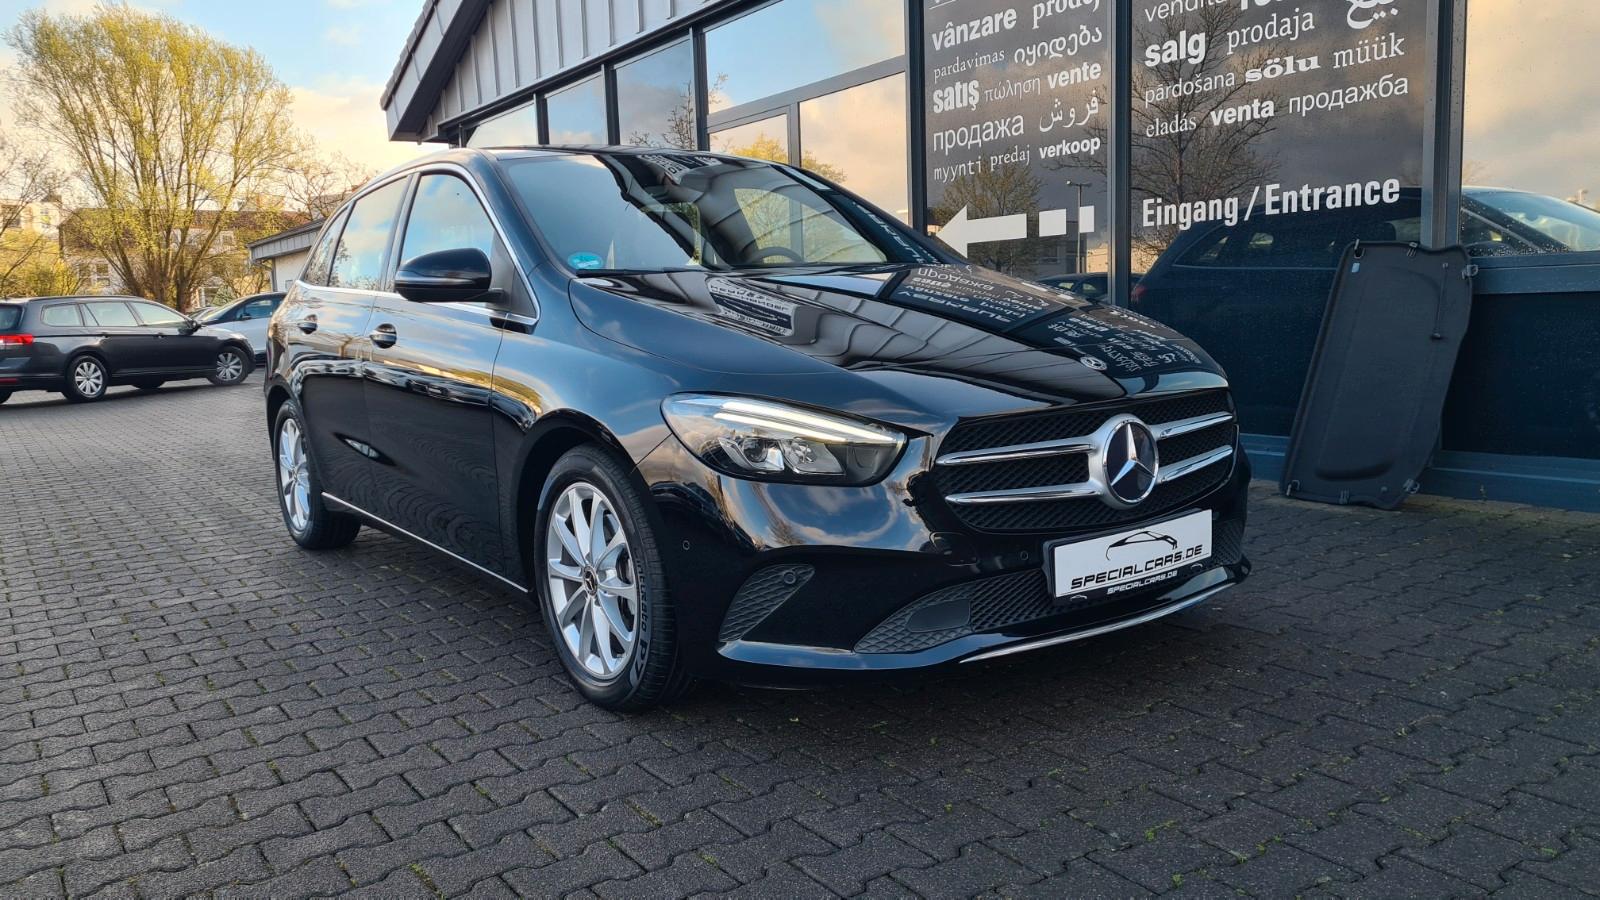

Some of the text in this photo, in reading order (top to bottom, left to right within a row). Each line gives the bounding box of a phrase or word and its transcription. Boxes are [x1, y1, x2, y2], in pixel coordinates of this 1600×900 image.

[932, 8, 1017, 51] vânzare
[1144, 7, 1315, 67] salg prodaja
[934, 50, 1005, 84] pardavimas
[1047, 61, 1101, 89] vente
[1145, 32, 1405, 108] pārdošana sölu müük
[933, 79, 980, 113] satış
[984, 77, 1041, 102] πώληση
[1039, 89, 1099, 132] فروش
[1288, 73, 1409, 117] продажба
[933, 114, 1024, 156] продажа
[1146, 99, 1275, 138] eladás venta
[934, 137, 1100, 183] myynti predaj verkoop
[1142, 196, 1239, 231] Eingang
[1265, 177, 1400, 215] Entrance
[1070, 544, 1203, 590] SPECIALCARS.DE
[1107, 570, 1178, 595] SPECIALCARS.DE
